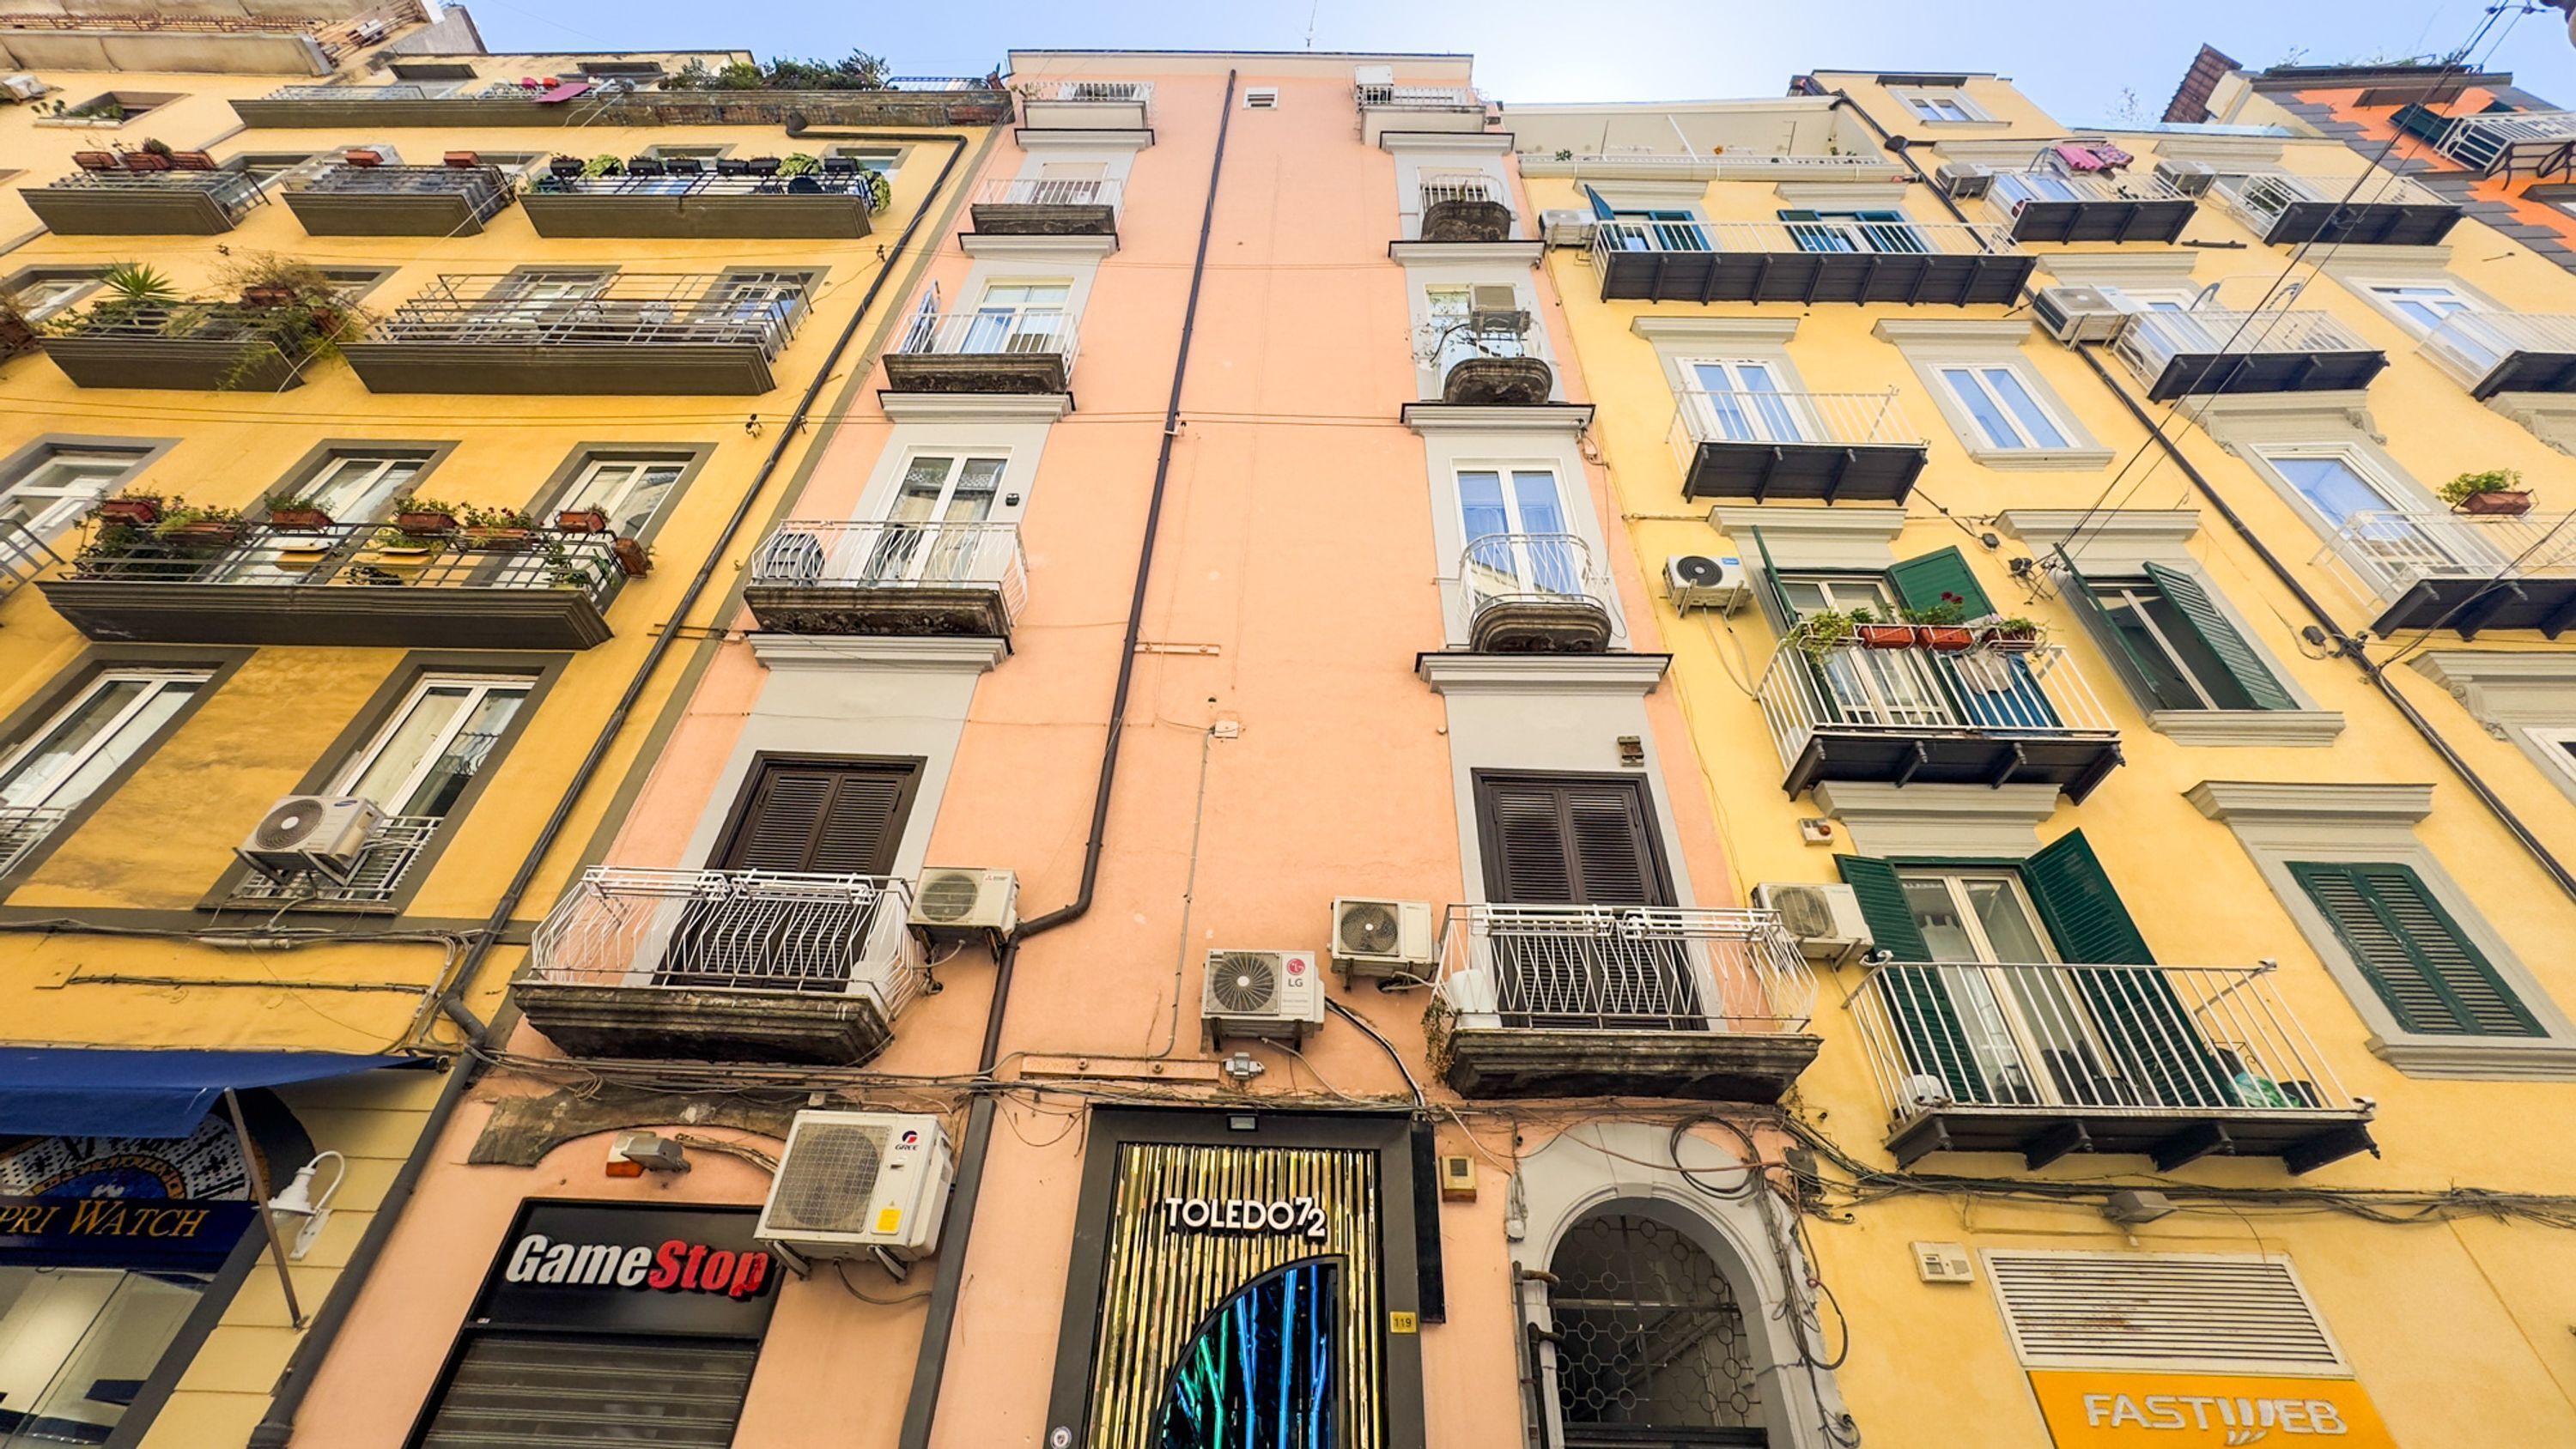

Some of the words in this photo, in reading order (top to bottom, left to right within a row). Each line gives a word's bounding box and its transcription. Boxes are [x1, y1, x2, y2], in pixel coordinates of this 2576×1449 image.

[1288, 979, 1303, 987] LG
[0, 1205, 60, 1234] PRI
[68, 1199, 210, 1237] WATCH
[505, 1234, 769, 1296] GameStop
[1394, 1318, 1412, 1328] 119
[2082, 1393, 2348, 1446] FASTWEB
